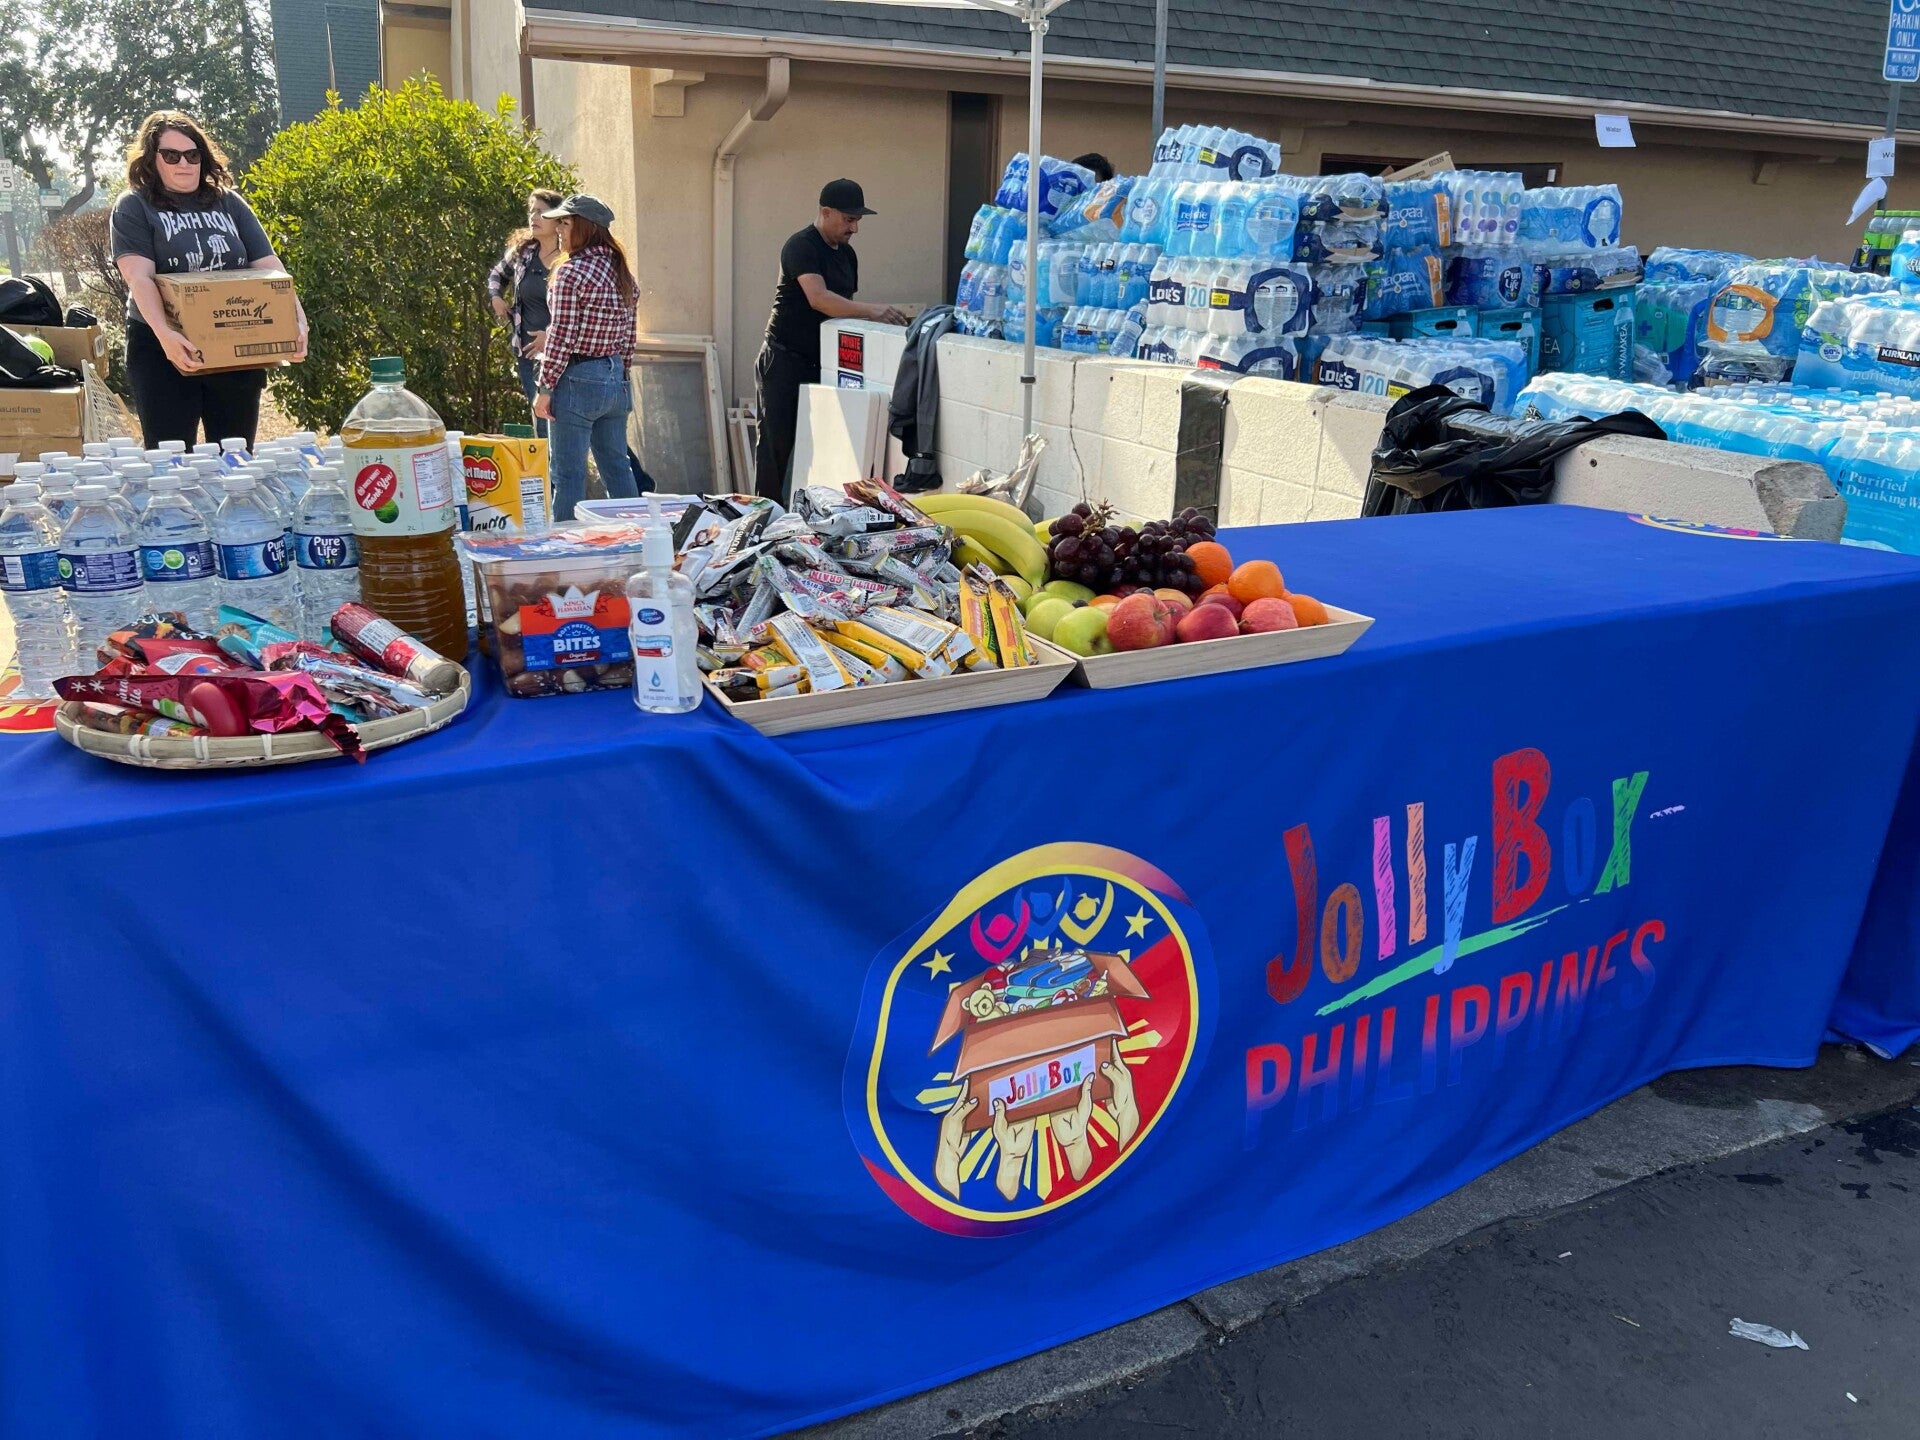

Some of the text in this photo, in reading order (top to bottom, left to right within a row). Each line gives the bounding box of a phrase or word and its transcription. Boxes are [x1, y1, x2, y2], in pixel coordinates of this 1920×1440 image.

[1892, 13, 1920, 29] PARKIN
[1896, 31, 1917, 47] ONLY
[1891, 52, 1915, 63] MINIMUM
[1887, 65, 1899, 76] FINE
[2, 177, 13, 188] 5
[158, 211, 241, 242] DEATH ROW
[168, 257, 179, 266] 19
[213, 303, 268, 319] SPECIAL K
[841, 335, 860, 350] PRIVATE
[1619, 323, 1629, 370] WAIAKEA
[839, 348, 862, 364] PROPERTY
[1881, 348, 1920, 361] KIRKLAN
[0, 406, 41, 414] ausfame
[464, 467, 497, 480] el Monte
[1849, 470, 1908, 493] Purified
[362, 487, 384, 509] Thank
[1845, 484, 1908, 509] Drinking
[267, 540, 285, 552] Pure
[313, 536, 341, 546] Pure
[271, 550, 286, 562] Life
[317, 546, 338, 558] Life
[810, 570, 843, 584] GRAIN
[557, 623, 596, 638] SOFT PRETZEL
[553, 636, 600, 652] BITES
[1243, 920, 1666, 1152] PHILIPPINES
